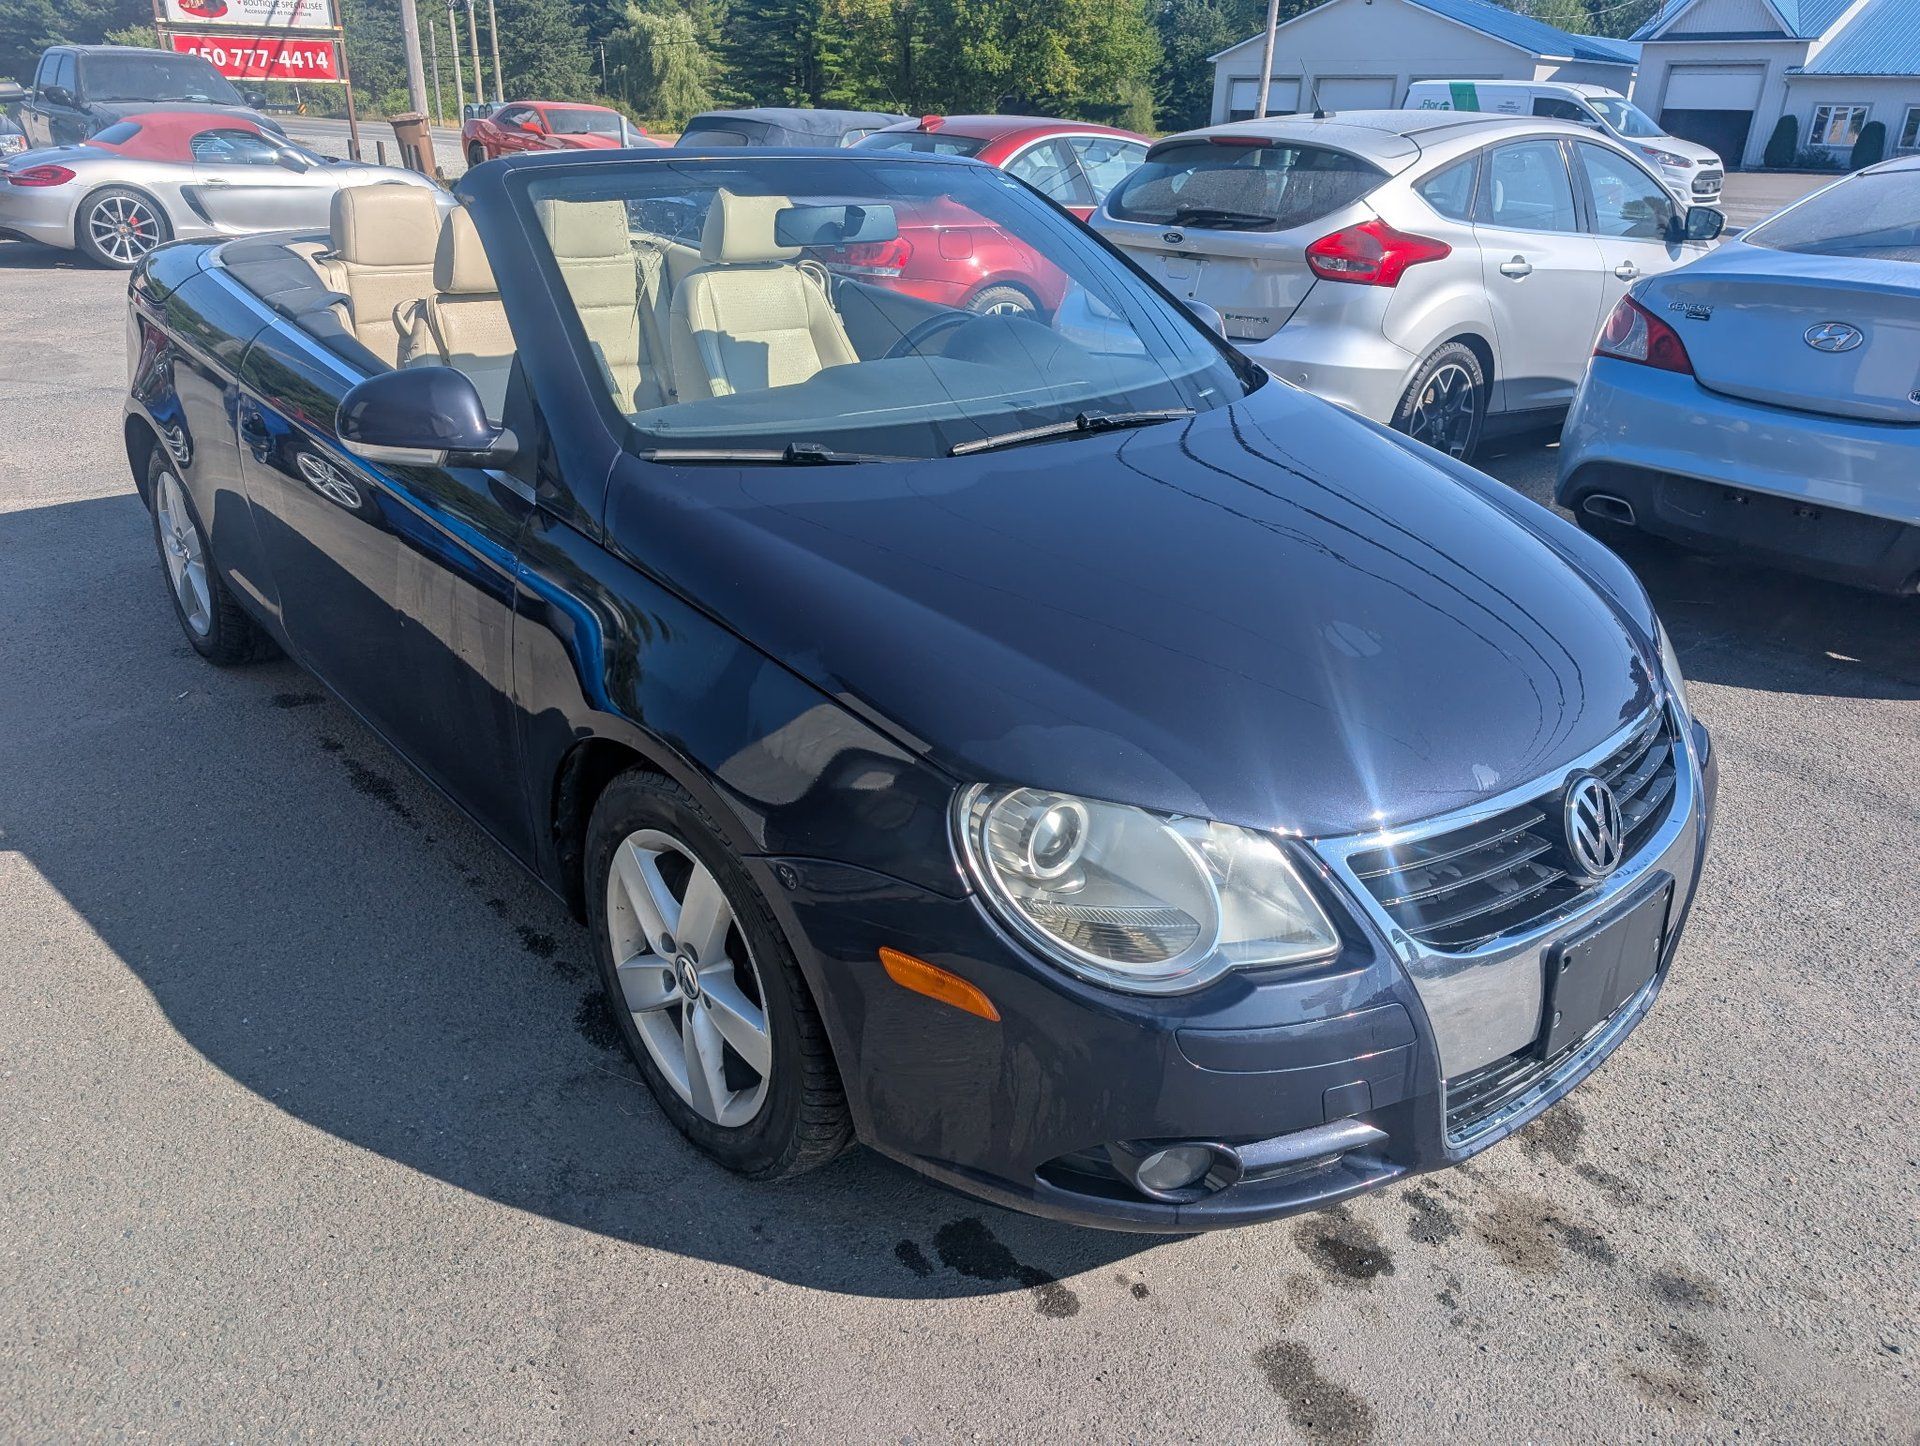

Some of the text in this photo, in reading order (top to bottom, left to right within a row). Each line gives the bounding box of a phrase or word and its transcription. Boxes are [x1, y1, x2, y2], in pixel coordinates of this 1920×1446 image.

[243, 0, 280, 8] BOUTIQUE
[229, 48, 329, 70] 777-4414
[1668, 302, 1713, 314] GENESIS
